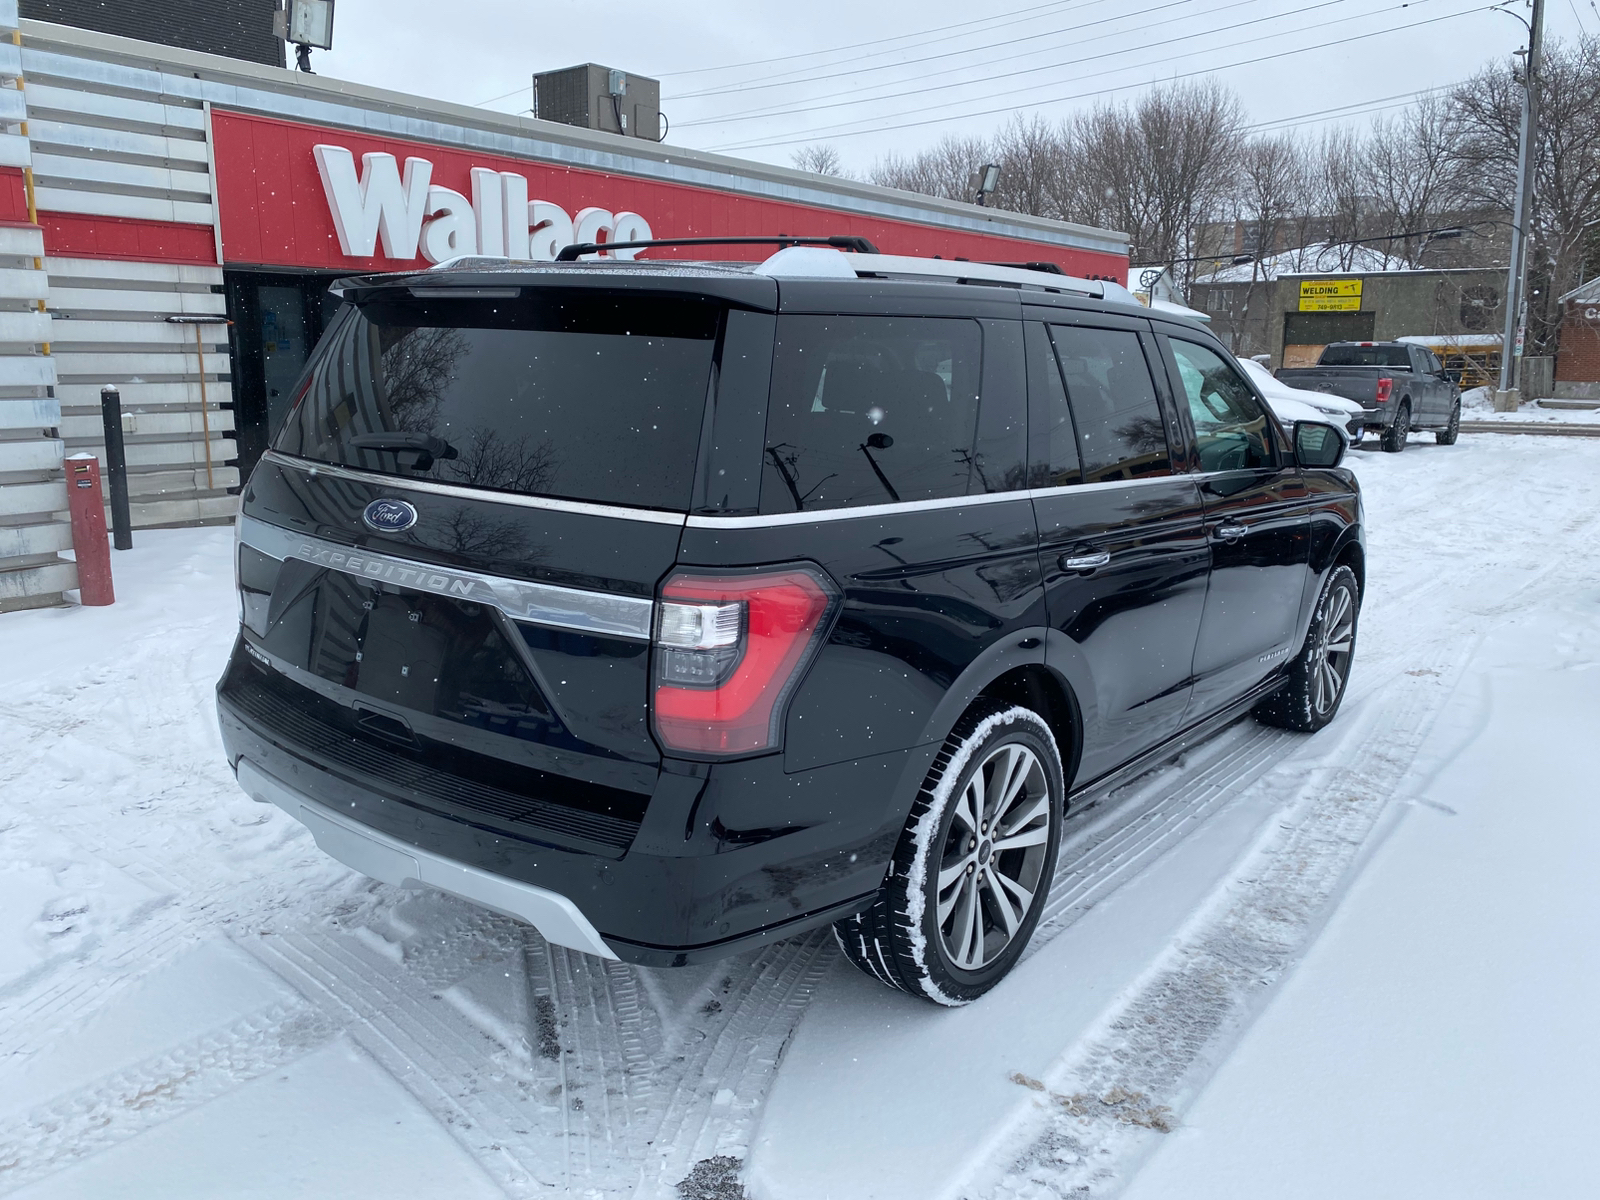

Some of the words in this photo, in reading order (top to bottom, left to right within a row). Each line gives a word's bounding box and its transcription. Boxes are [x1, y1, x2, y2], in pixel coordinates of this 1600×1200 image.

[312, 144, 653, 263] Wallace
[372, 503, 403, 523] Ford
[299, 544, 476, 596] EXPEDITION
